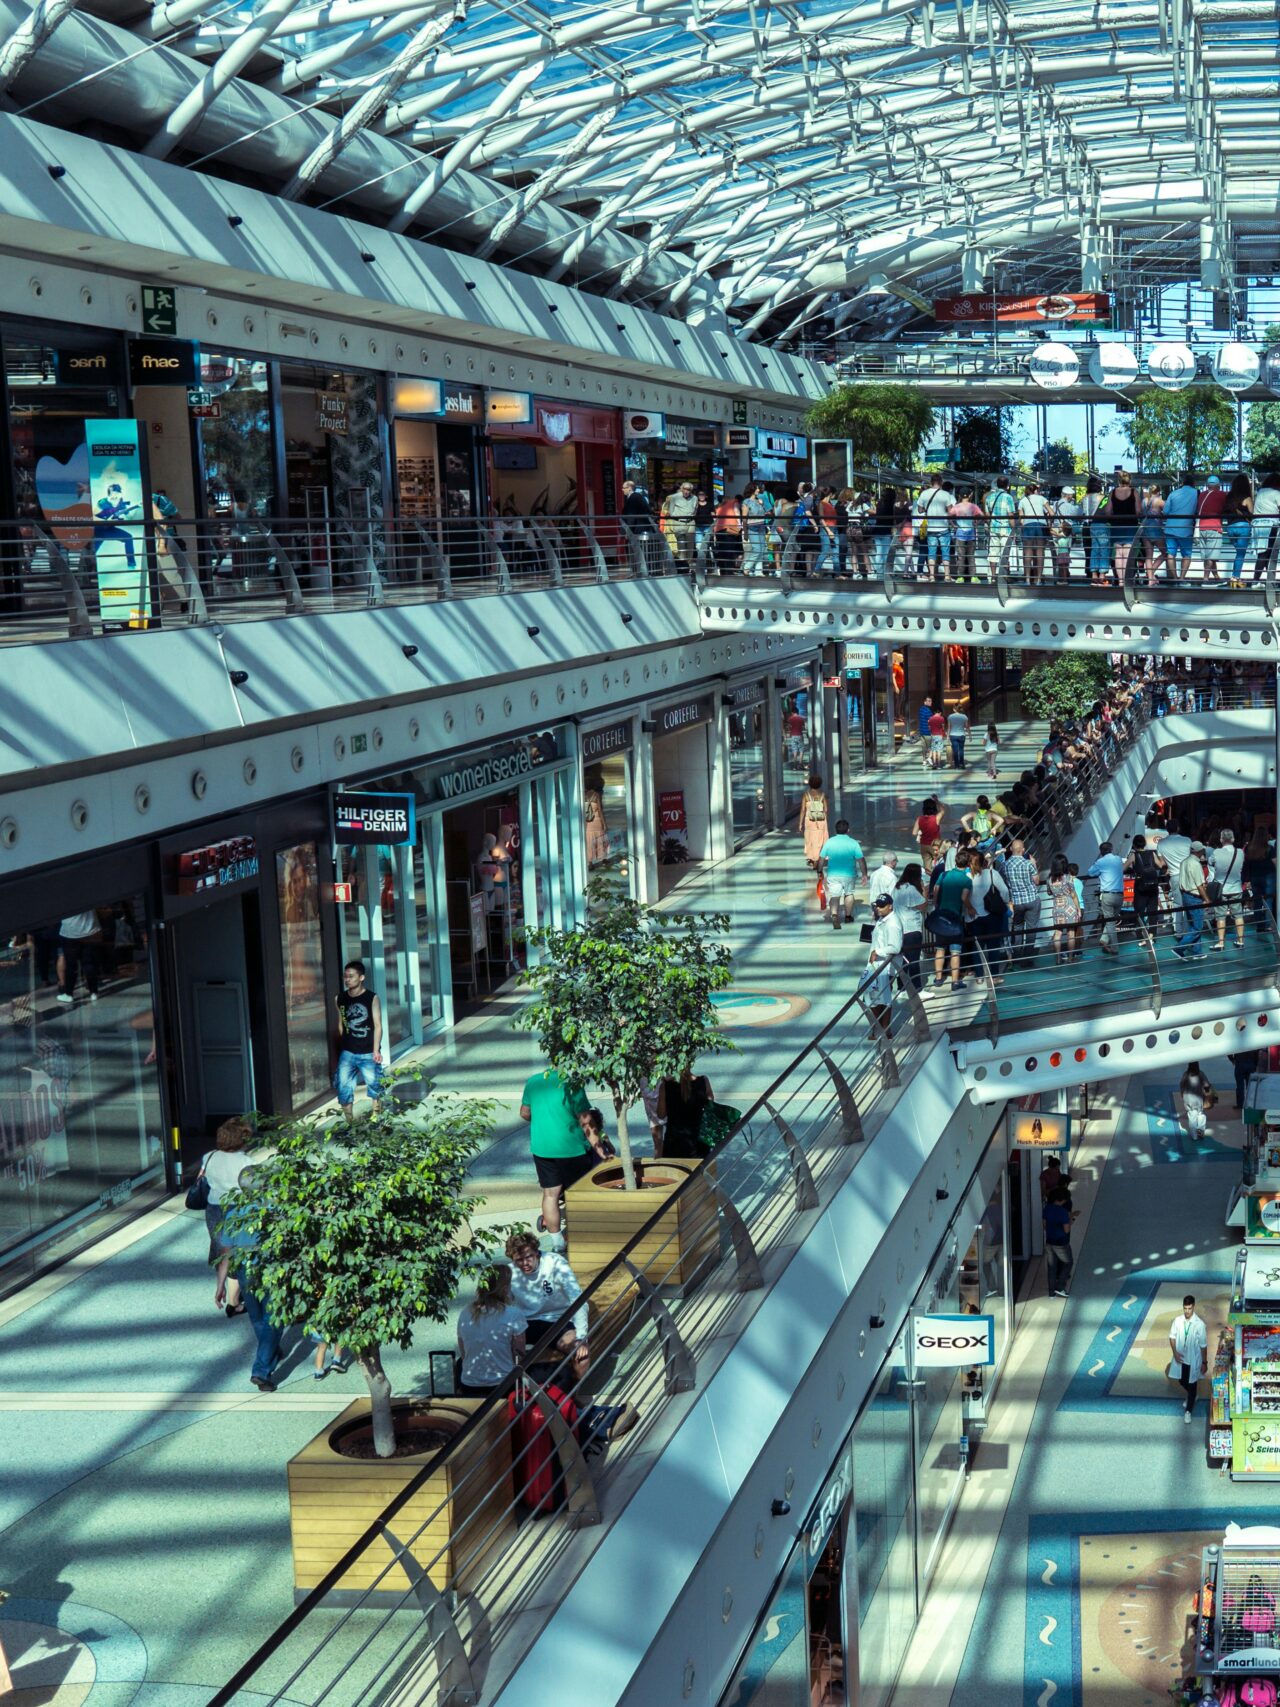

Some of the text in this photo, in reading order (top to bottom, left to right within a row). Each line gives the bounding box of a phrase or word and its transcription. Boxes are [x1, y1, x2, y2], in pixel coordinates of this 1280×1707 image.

[979, 302, 1030, 311] KIROSUSHI
[142, 355, 179, 367] fnac
[322, 395, 345, 413] Funky
[320, 413, 346, 431] Project
[842, 652, 873, 660] CORTEFIEL
[663, 703, 699, 730] CORTEFIEL
[583, 727, 627, 756] CORTEFIEL
[338, 807, 406, 822] HILFIGER
[364, 821, 407, 832] DENIM
[1034, 1139, 1059, 1147] Puppies
[918, 1334, 989, 1349] GEOX
[810, 1455, 851, 1557] GEOX
